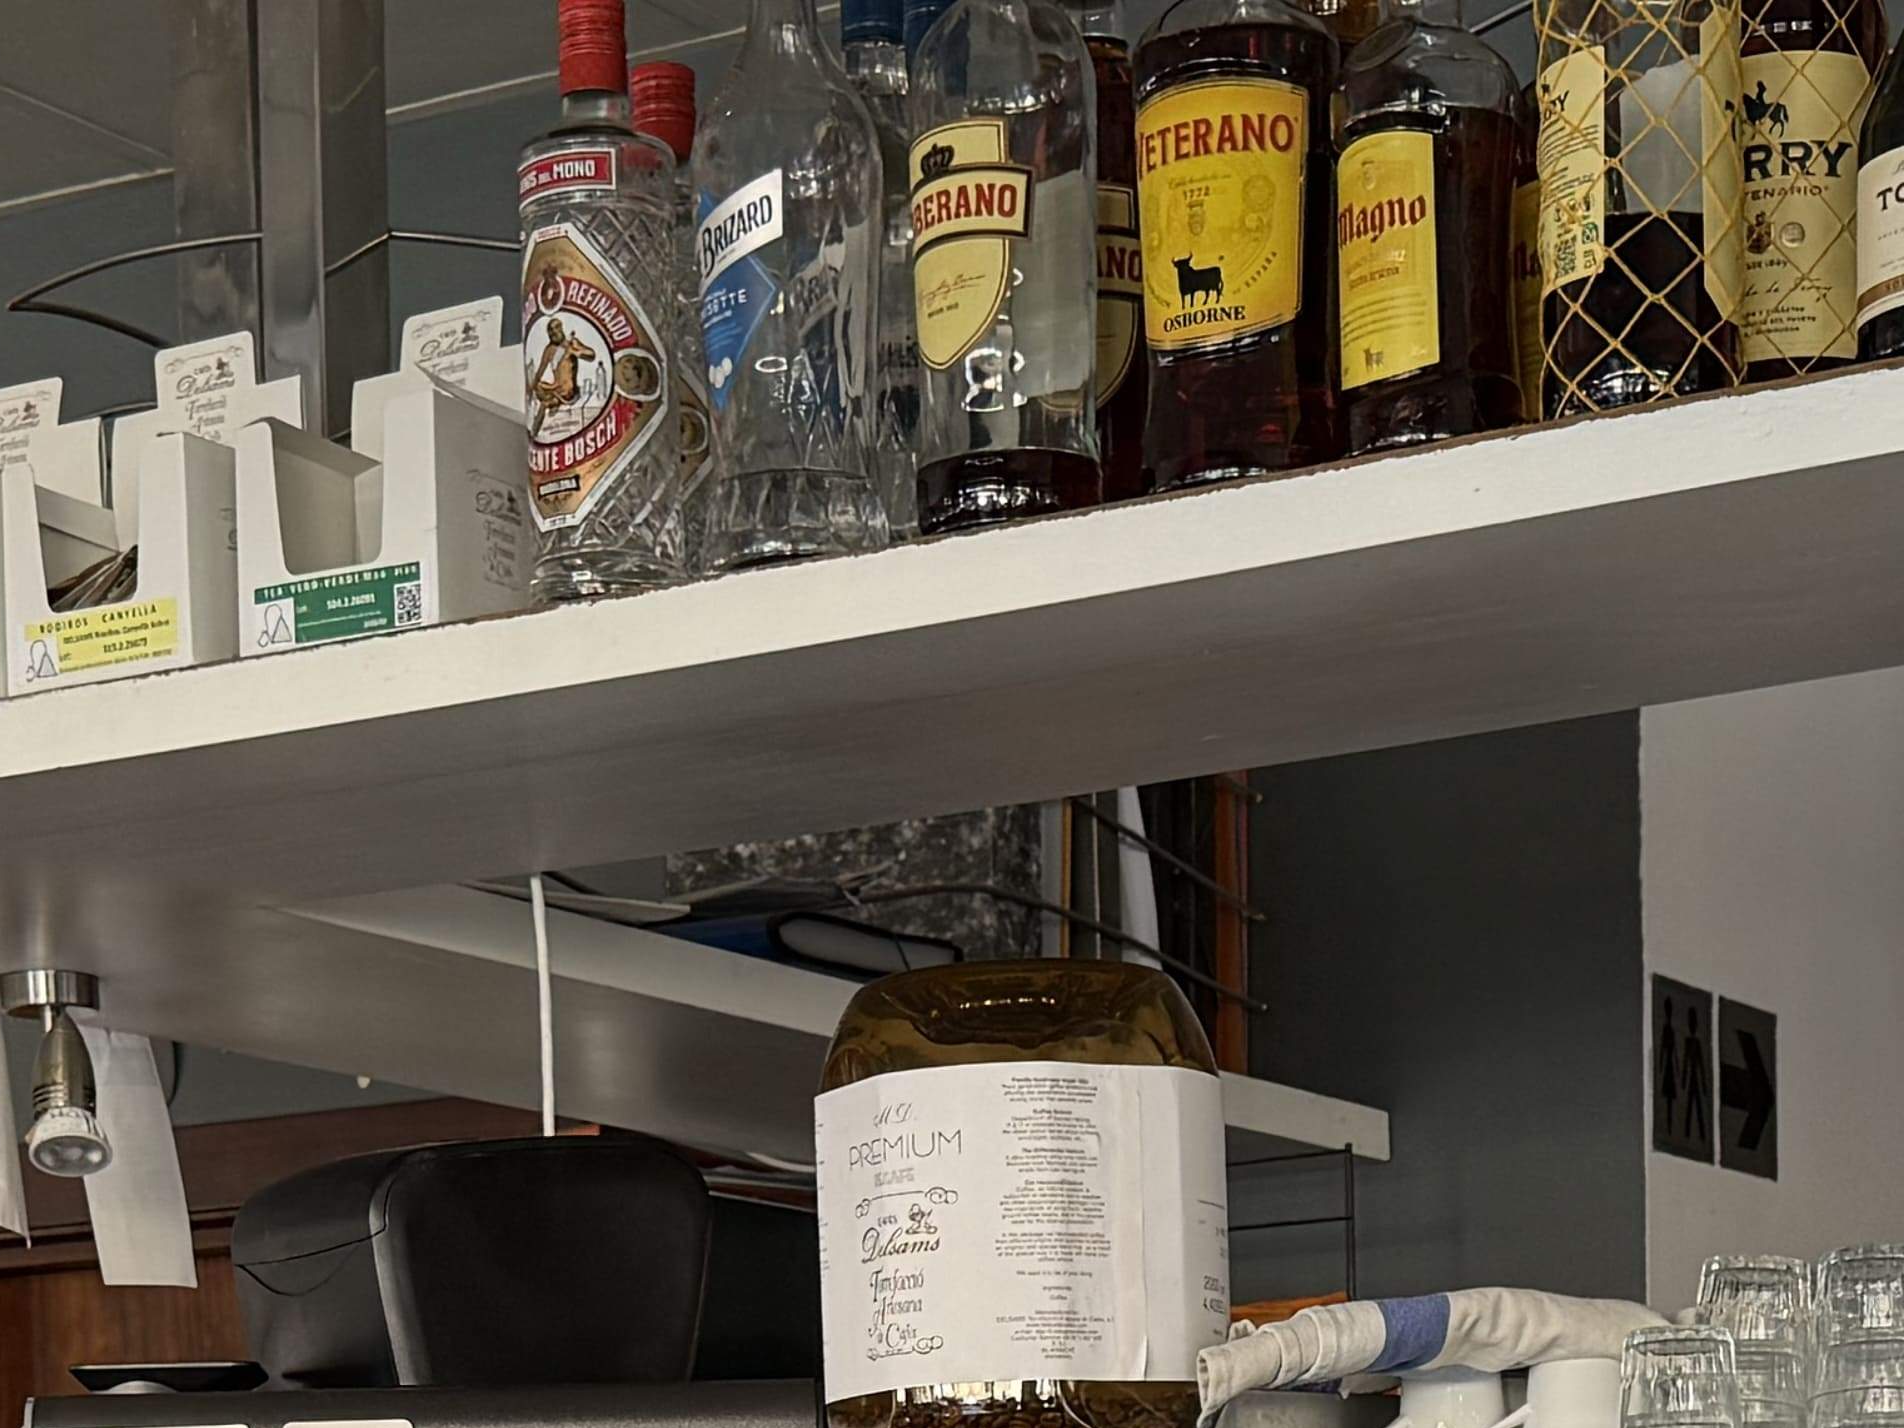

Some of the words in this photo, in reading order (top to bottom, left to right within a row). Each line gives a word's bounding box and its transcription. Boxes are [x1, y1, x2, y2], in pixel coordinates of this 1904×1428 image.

[552, 159, 596, 180] MONO
[701, 194, 773, 280] BRIZARD
[1337, 194, 1427, 249] Magno
[565, 281, 635, 343] REFINADO
[1163, 305, 1246, 333] OSBORNE
[563, 406, 619, 468] BOSCH
[848, 1128, 963, 1171] PREMIUM
